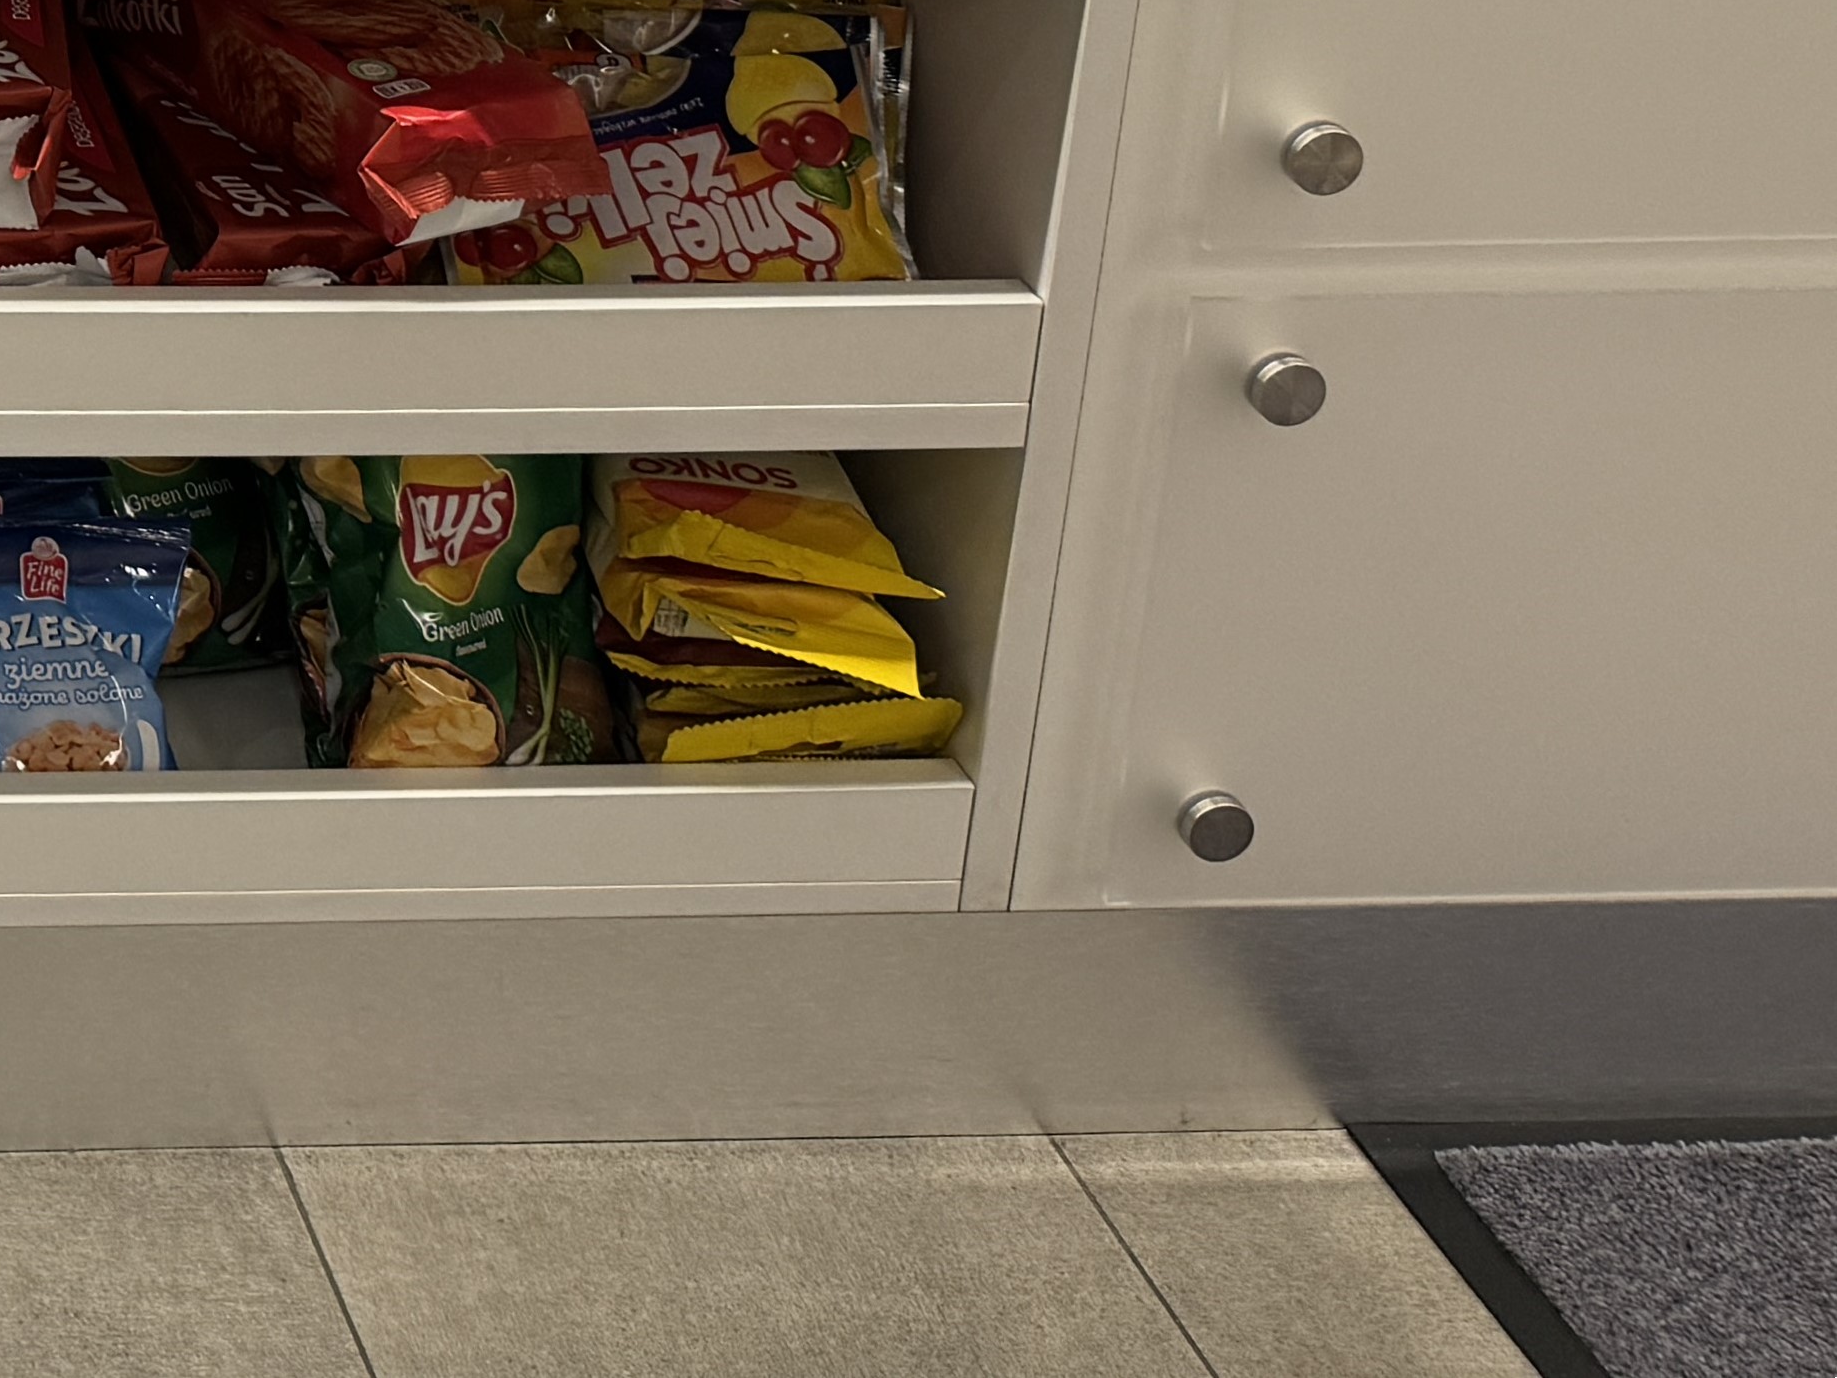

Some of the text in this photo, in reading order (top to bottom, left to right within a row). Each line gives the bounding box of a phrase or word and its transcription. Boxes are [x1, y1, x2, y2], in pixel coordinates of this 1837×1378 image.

[628, 454, 798, 491] SONKO
[126, 472, 234, 515] Green Onion
[404, 477, 511, 568] Lay's
[25, 560, 64, 581] Fine
[28, 578, 63, 597] Life
[421, 605, 506, 643] Green Onion
[2, 660, 111, 687] ziemne
